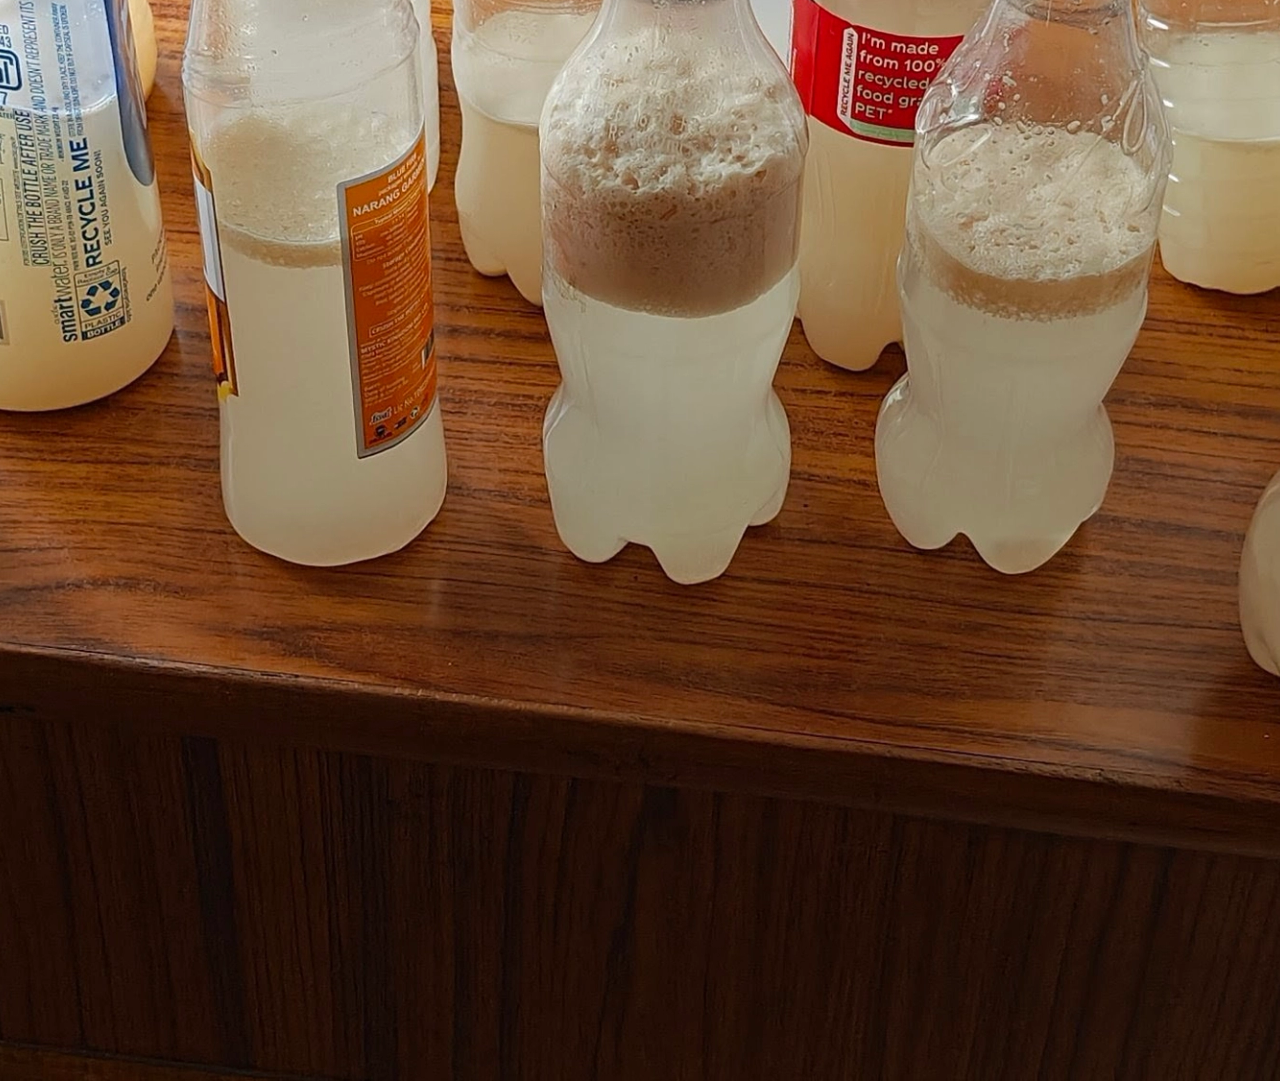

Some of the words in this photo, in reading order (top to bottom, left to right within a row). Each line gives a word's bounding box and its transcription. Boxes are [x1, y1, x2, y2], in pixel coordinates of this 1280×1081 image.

[18, 0, 34, 14] ITS
[20, 14, 40, 61] REPRESENT
[845, 31, 856, 56] AGAIN
[861, 31, 886, 50] I'm
[890, 41, 940, 55] made
[843, 57, 854, 77] ME
[859, 49, 899, 70] from
[26, 60, 45, 96] DOESN'T
[858, 68, 931, 91] recycled
[30, 95, 48, 114] AND
[839, 76, 852, 118] RECYCLE
[856, 84, 894, 105] food
[14, 110, 33, 131] USE
[33, 113, 52, 137] MARK
[18, 134, 38, 167] AFTER
[37, 136, 55, 161] TRADE
[68, 137, 91, 173] ME
[40, 162, 57, 175] OR
[94, 149, 107, 179] SOON!
[21, 169, 43, 208] BOTTLE
[40, 175, 59, 198] NAME
[97, 179, 108, 208] AGAIN
[45, 199, 63, 225] BRAND
[352, 188, 401, 218] NARANG
[25, 210, 45, 229] THE
[74, 176, 104, 269] RECYCLE
[99, 208, 111, 228] YOU
[28, 231, 51, 265] CRUSH
[49, 233, 67, 252] ONLY
[103, 227, 113, 247] SEE
[84, 310, 122, 330] PLASTIC
[87, 320, 123, 338] BOTTLE
